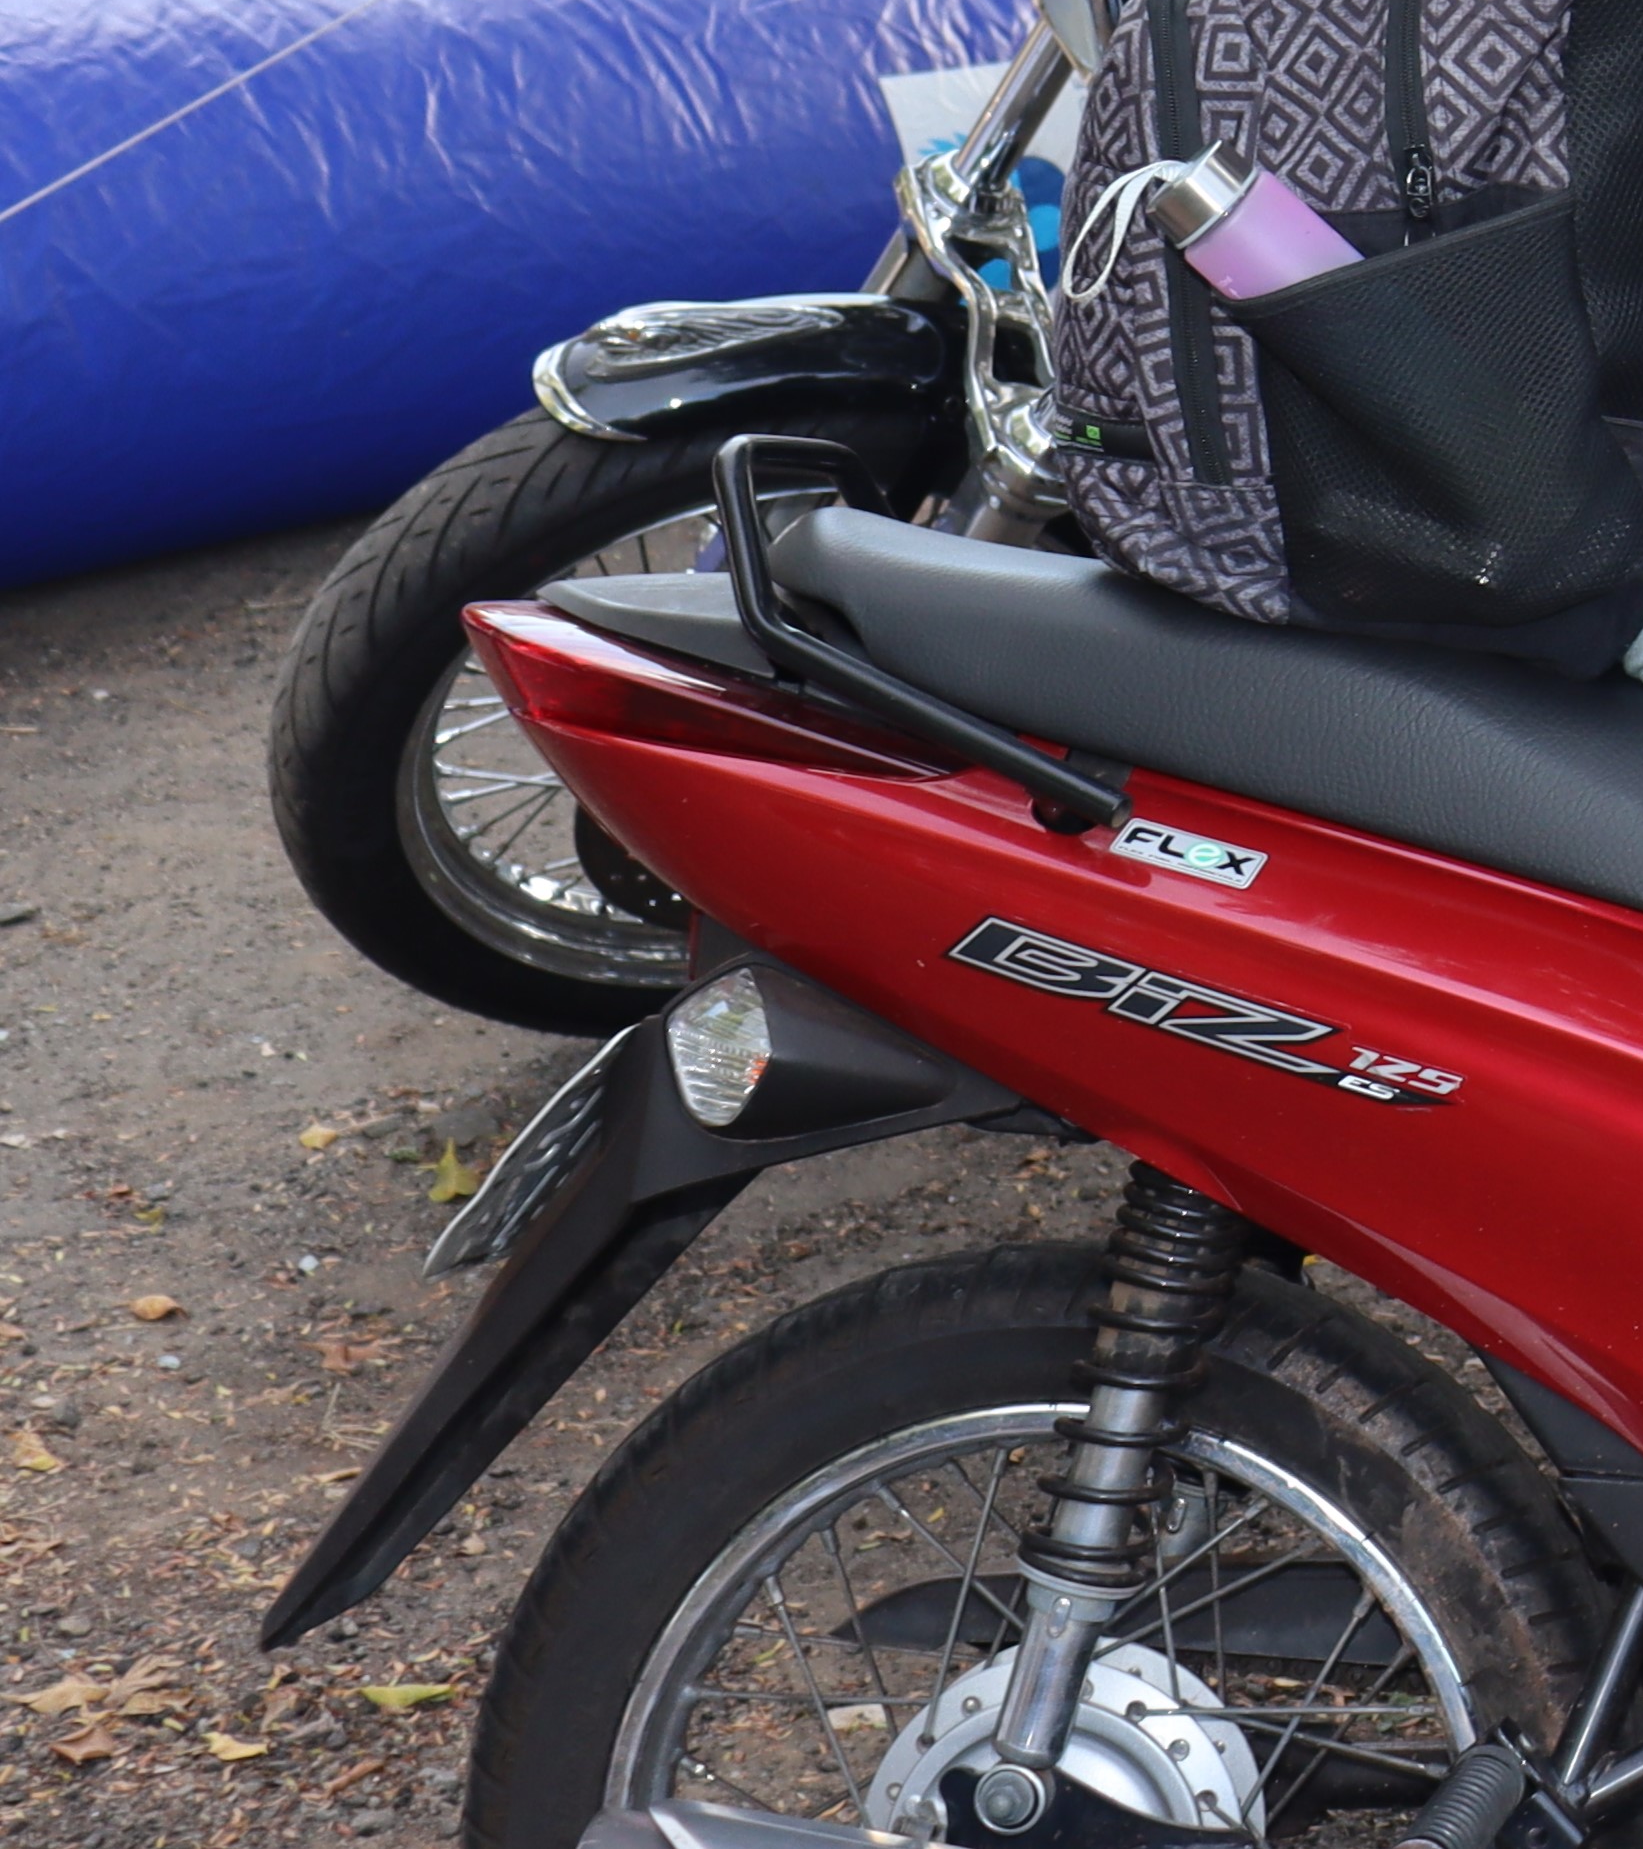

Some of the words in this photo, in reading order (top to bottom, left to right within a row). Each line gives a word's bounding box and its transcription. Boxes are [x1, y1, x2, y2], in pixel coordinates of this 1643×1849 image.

[1123, 827, 1255, 877] FLEX
[1337, 1075, 1400, 1101] ES
[1349, 1046, 1465, 1096] 125
